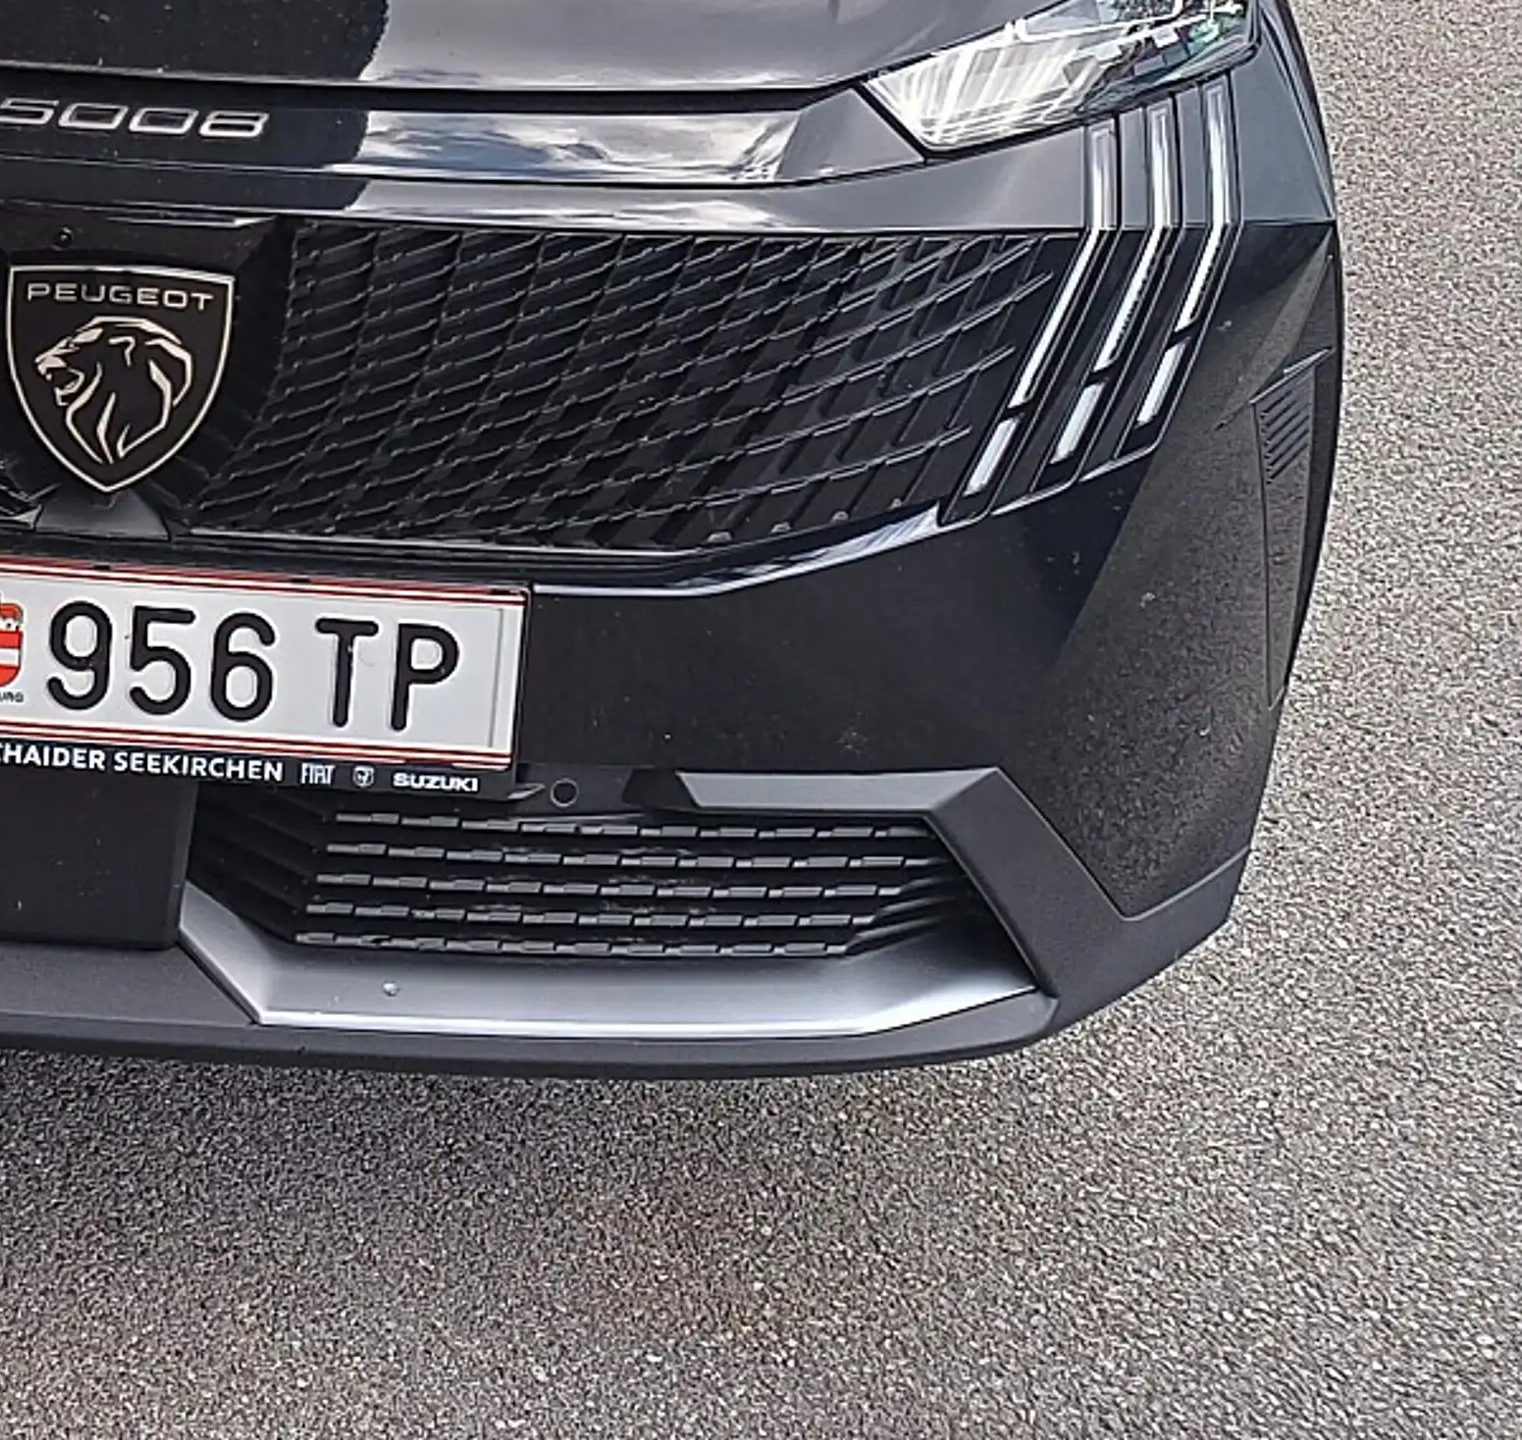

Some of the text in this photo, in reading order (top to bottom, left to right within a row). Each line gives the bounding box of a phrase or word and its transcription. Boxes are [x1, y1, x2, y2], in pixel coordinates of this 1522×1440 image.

[27, 283, 214, 310] PEUGEOT
[46, 600, 276, 722] 956
[315, 618, 460, 732] TP
[114, 753, 283, 782] SEEKIRCHEN
[301, 764, 335, 785] FIAT
[393, 773, 479, 792] SUZUKI
